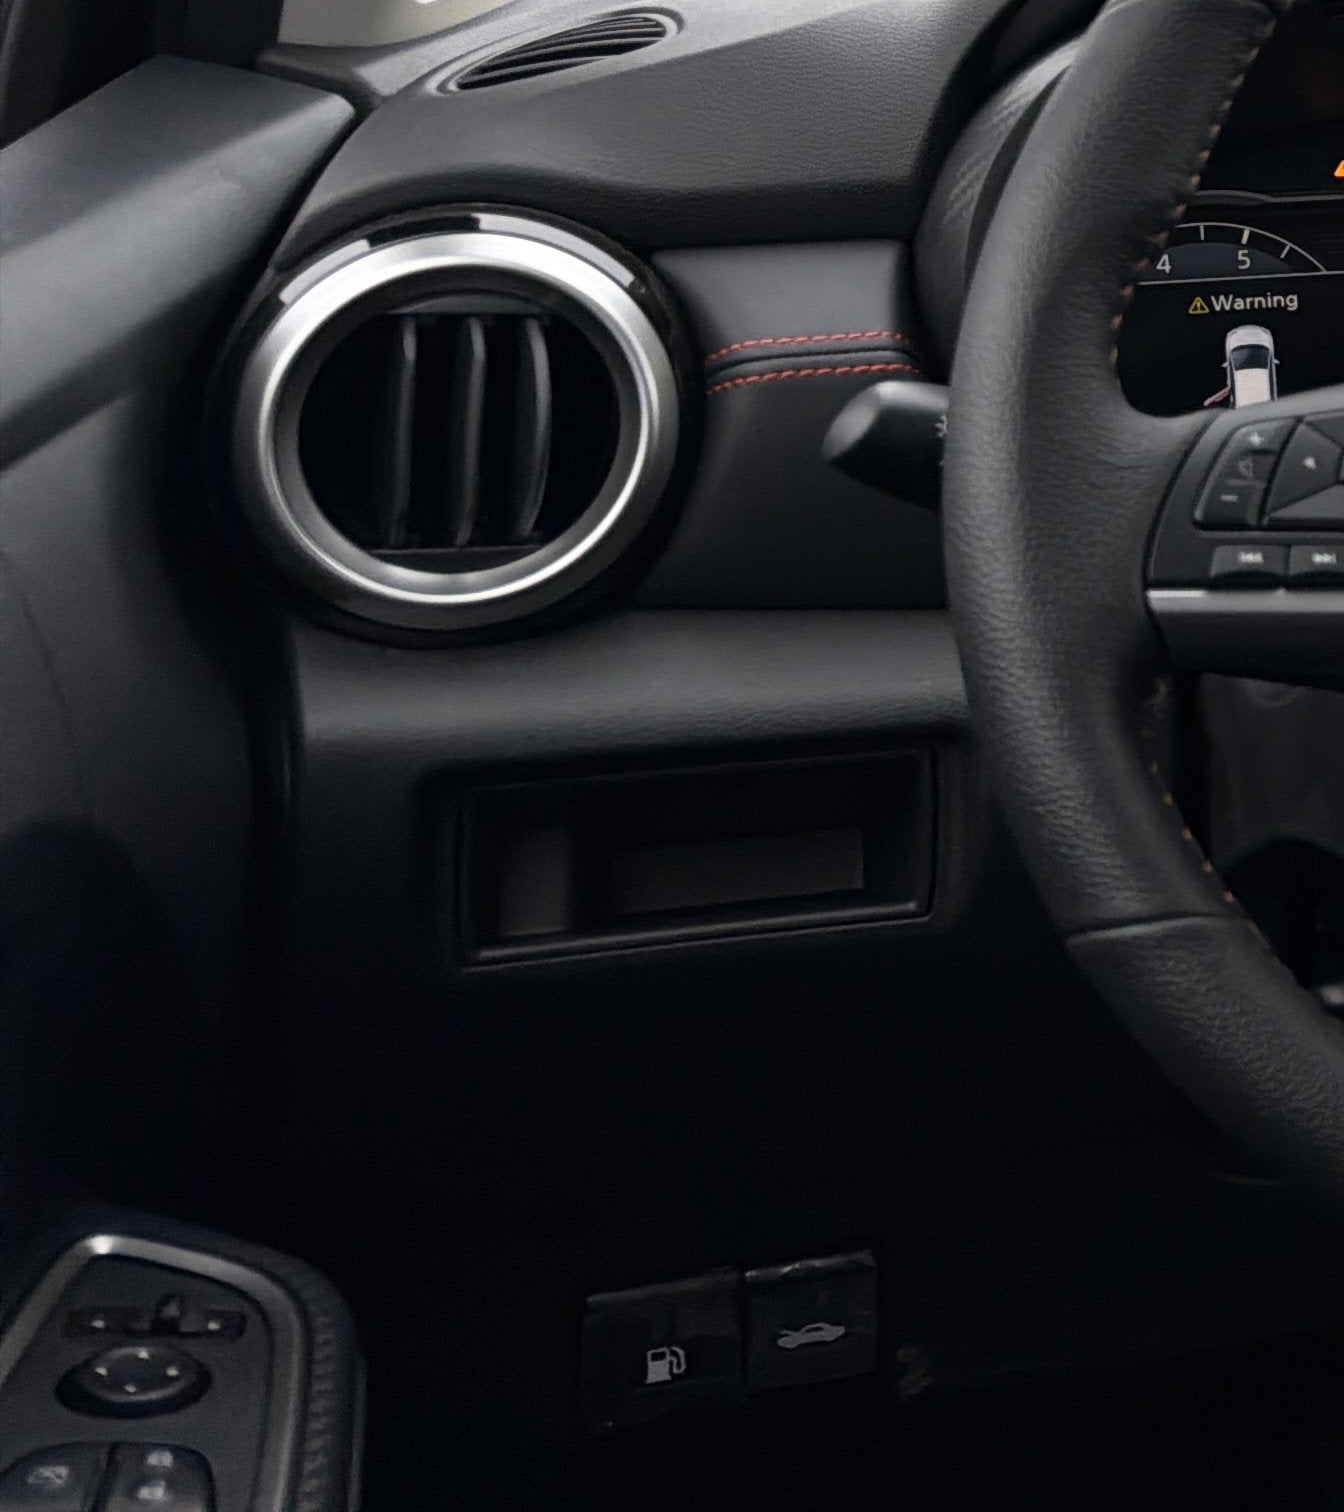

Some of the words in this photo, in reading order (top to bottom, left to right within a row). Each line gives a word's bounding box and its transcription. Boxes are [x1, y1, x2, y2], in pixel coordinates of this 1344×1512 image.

[1155, 253, 1172, 274] 4
[1237, 248, 1251, 270] 5
[1211, 291, 1298, 312] Warning
